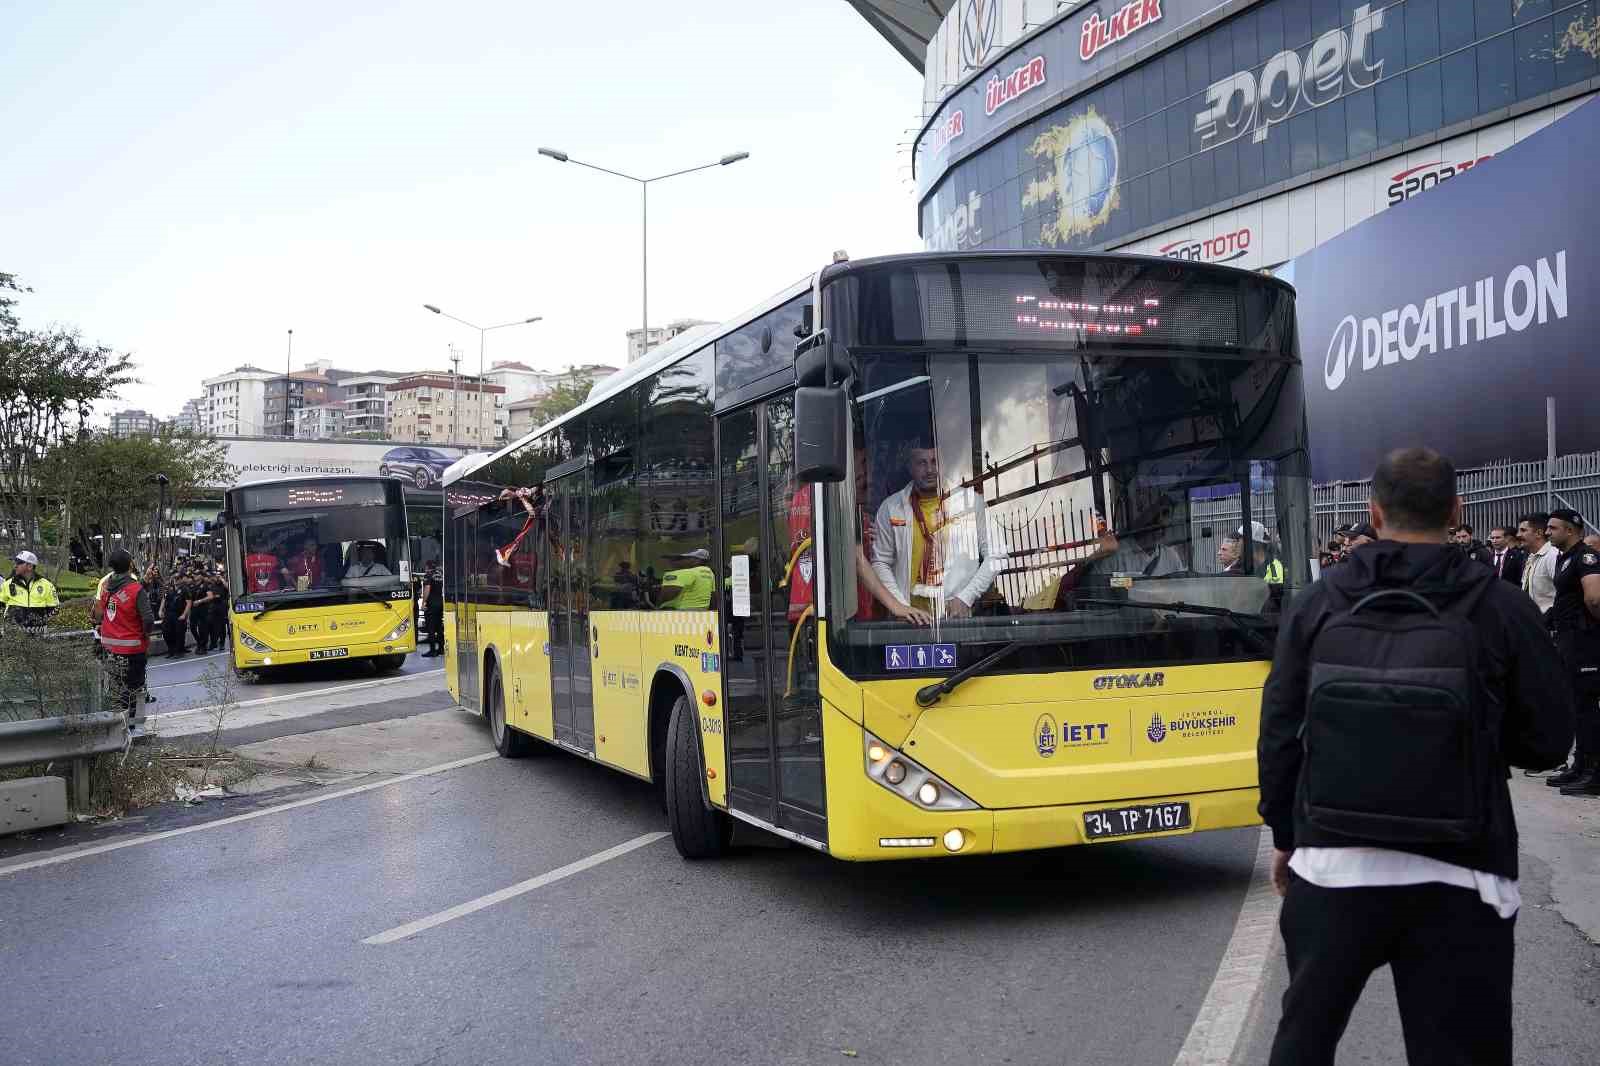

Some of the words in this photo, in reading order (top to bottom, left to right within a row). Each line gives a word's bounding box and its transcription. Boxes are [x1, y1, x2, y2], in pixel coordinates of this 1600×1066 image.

[1080, 0, 1162, 60] ÜLKER
[986, 56, 1046, 116] ÜLKER
[1362, 249, 1568, 371] DECATHLON
[674, 644, 689, 657] KENT
[1093, 672, 1165, 690] OTOKAR
[1063, 722, 1109, 742] İETT
[1094, 814, 1112, 834] 34
[1120, 810, 1138, 831] TP
[1145, 806, 1182, 829] 7167
